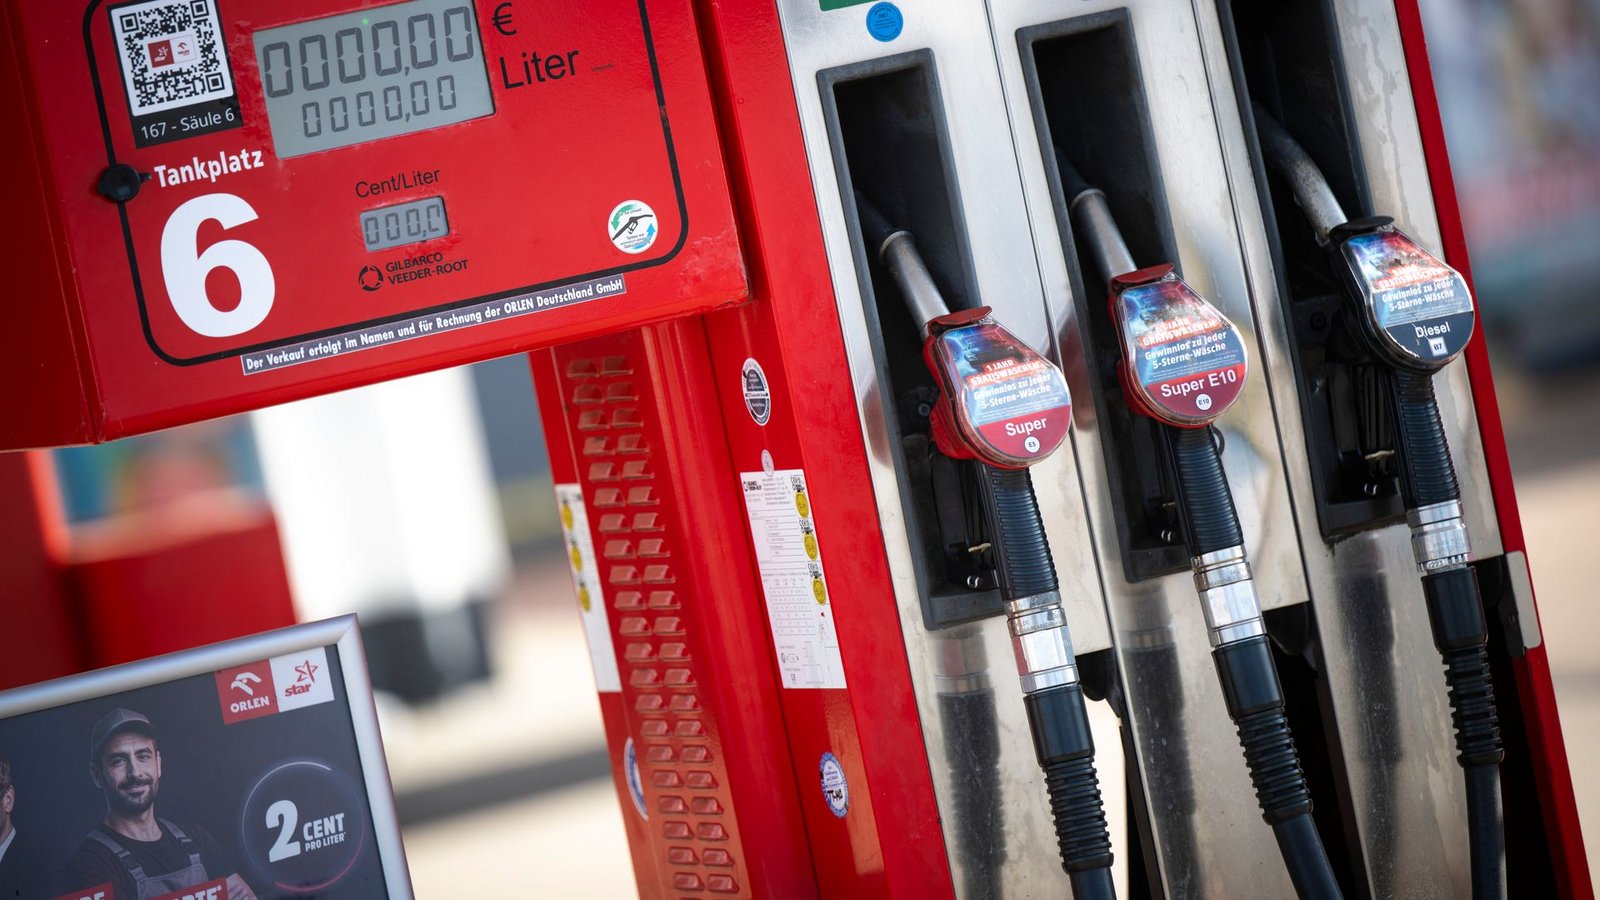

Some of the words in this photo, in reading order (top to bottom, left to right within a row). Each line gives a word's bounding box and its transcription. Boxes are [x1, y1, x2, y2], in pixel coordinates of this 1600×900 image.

[491, 2, 517, 36] €
[262, 6, 474, 98] 0000,00
[499, 50, 579, 89] Liter
[302, 75, 457, 138] 0000,00
[141, 122, 166, 139] 167
[180, 112, 222, 131] Säule
[225, 108, 235, 121] 6
[154, 148, 264, 187] Tankplatz
[355, 169, 440, 198] Cent/Liter
[160, 192, 276, 338] 6
[385, 252, 443, 272] GILBARCO
[388, 259, 468, 285] VEEDER-ROOT
[1382, 286, 1422, 303] Gewinnlos
[1423, 283, 1432, 291] zu
[246, 357, 264, 370] Der
[266, 347, 306, 366] Verkauf
[308, 340, 342, 357] erfolgt
[345, 337, 358, 349] im
[360, 330, 395, 345] Namen
[397, 322, 416, 337] und
[418, 320, 434, 333] für
[436, 311, 482, 328] Rechnung
[485, 305, 501, 318] der
[504, 297, 535, 314] ORLEN
[536, 285, 594, 308] Deutschland
[595, 279, 624, 295] GmbH
[1416, 322, 1450, 338] Diesel
[1145, 341, 1191, 360] Gewinnlos
[1192, 338, 1202, 347] zu
[1152, 342, 1226, 369] 5-Sterne-Wäsche
[993, 360, 1014, 370] JAHR
[973, 383, 1017, 400] Gewinnlos
[1017, 379, 1028, 388] zu
[1160, 378, 1205, 397] Super
[1208, 370, 1237, 387] E10
[1005, 418, 1047, 436] Super
[285, 683, 311, 697] star
[230, 696, 270, 713] ORLEN
[265, 799, 301, 863] 2
[303, 812, 345, 841] CENT
[305, 840, 321, 852] PRO
